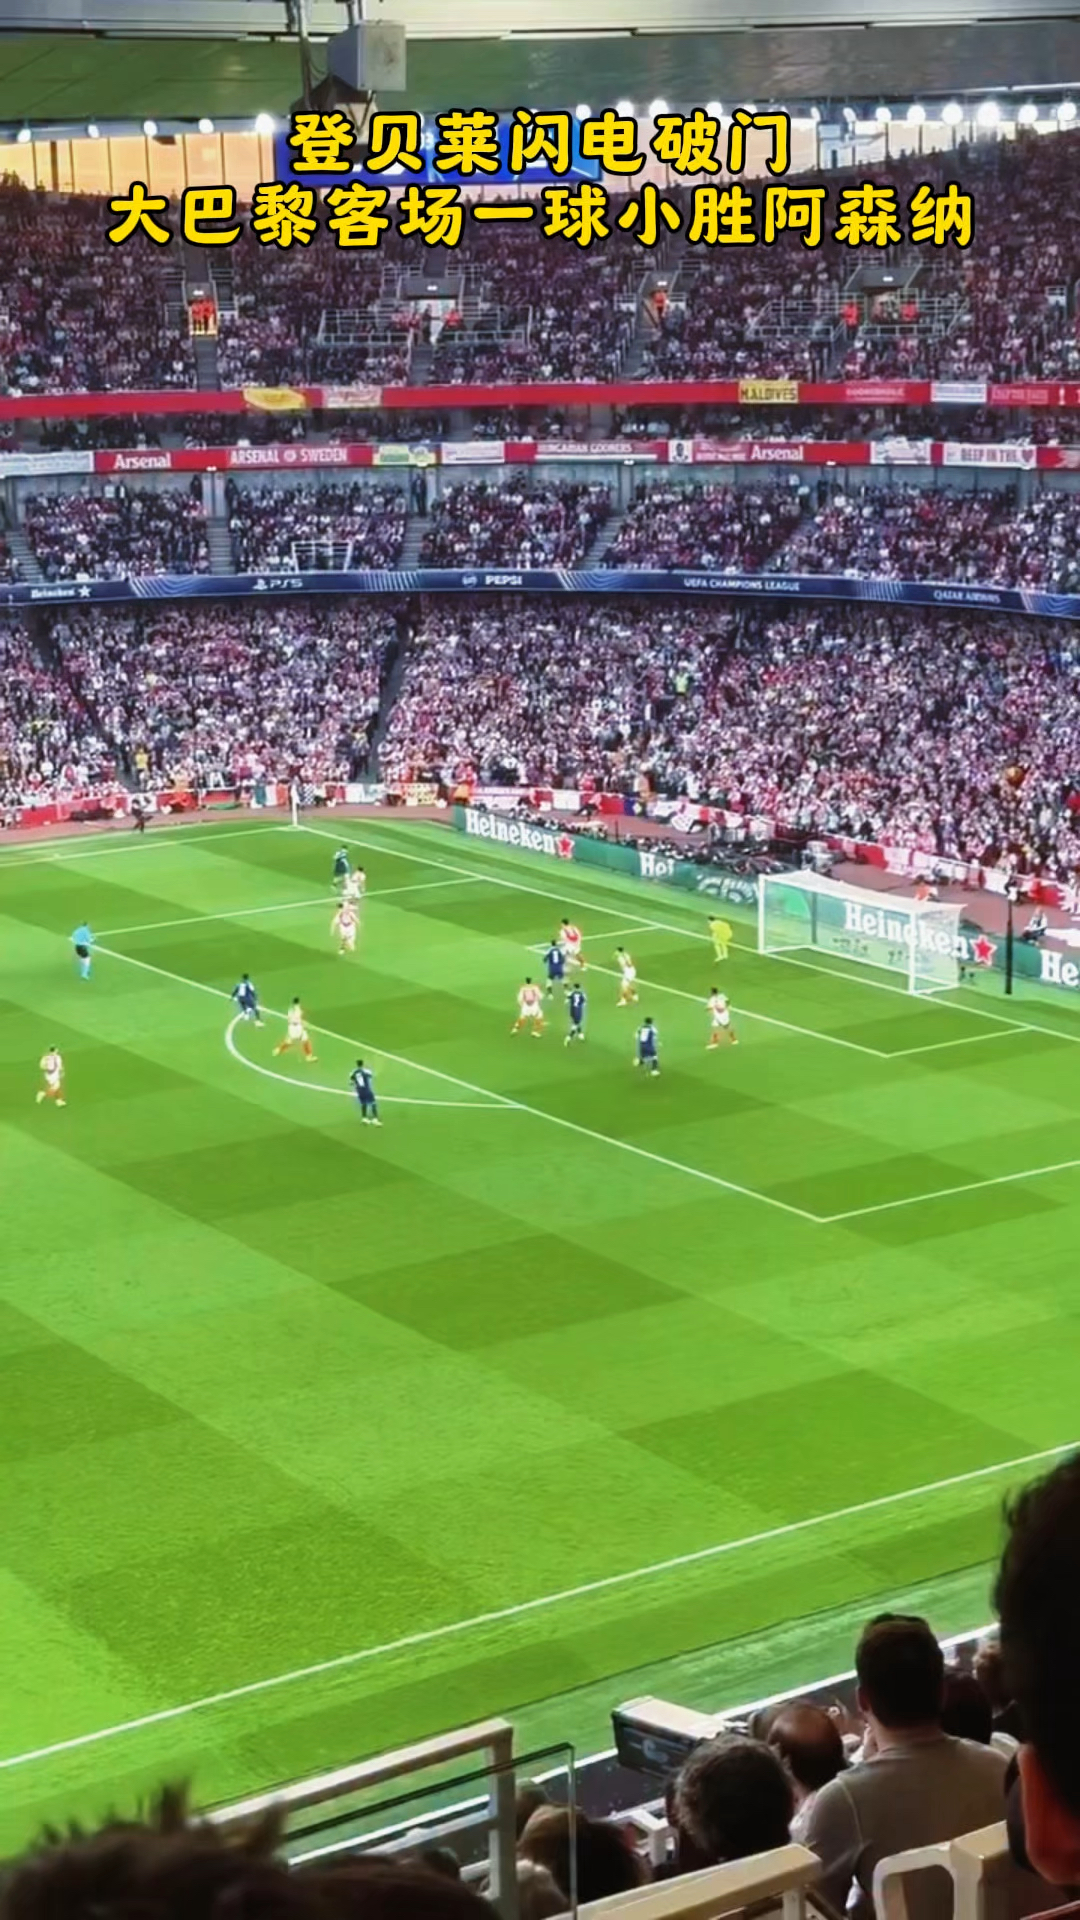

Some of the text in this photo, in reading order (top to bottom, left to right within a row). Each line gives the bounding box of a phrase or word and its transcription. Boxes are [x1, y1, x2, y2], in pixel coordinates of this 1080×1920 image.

[114, 452, 171, 470] Arsenal
[231, 447, 348, 464] ARSENAL SWEDEN
[751, 445, 804, 461] Arsenal
[485, 574, 523, 586] PEPSI
[709, 578, 763, 590] CHAMPIONS
[465, 808, 557, 856] Heineken
